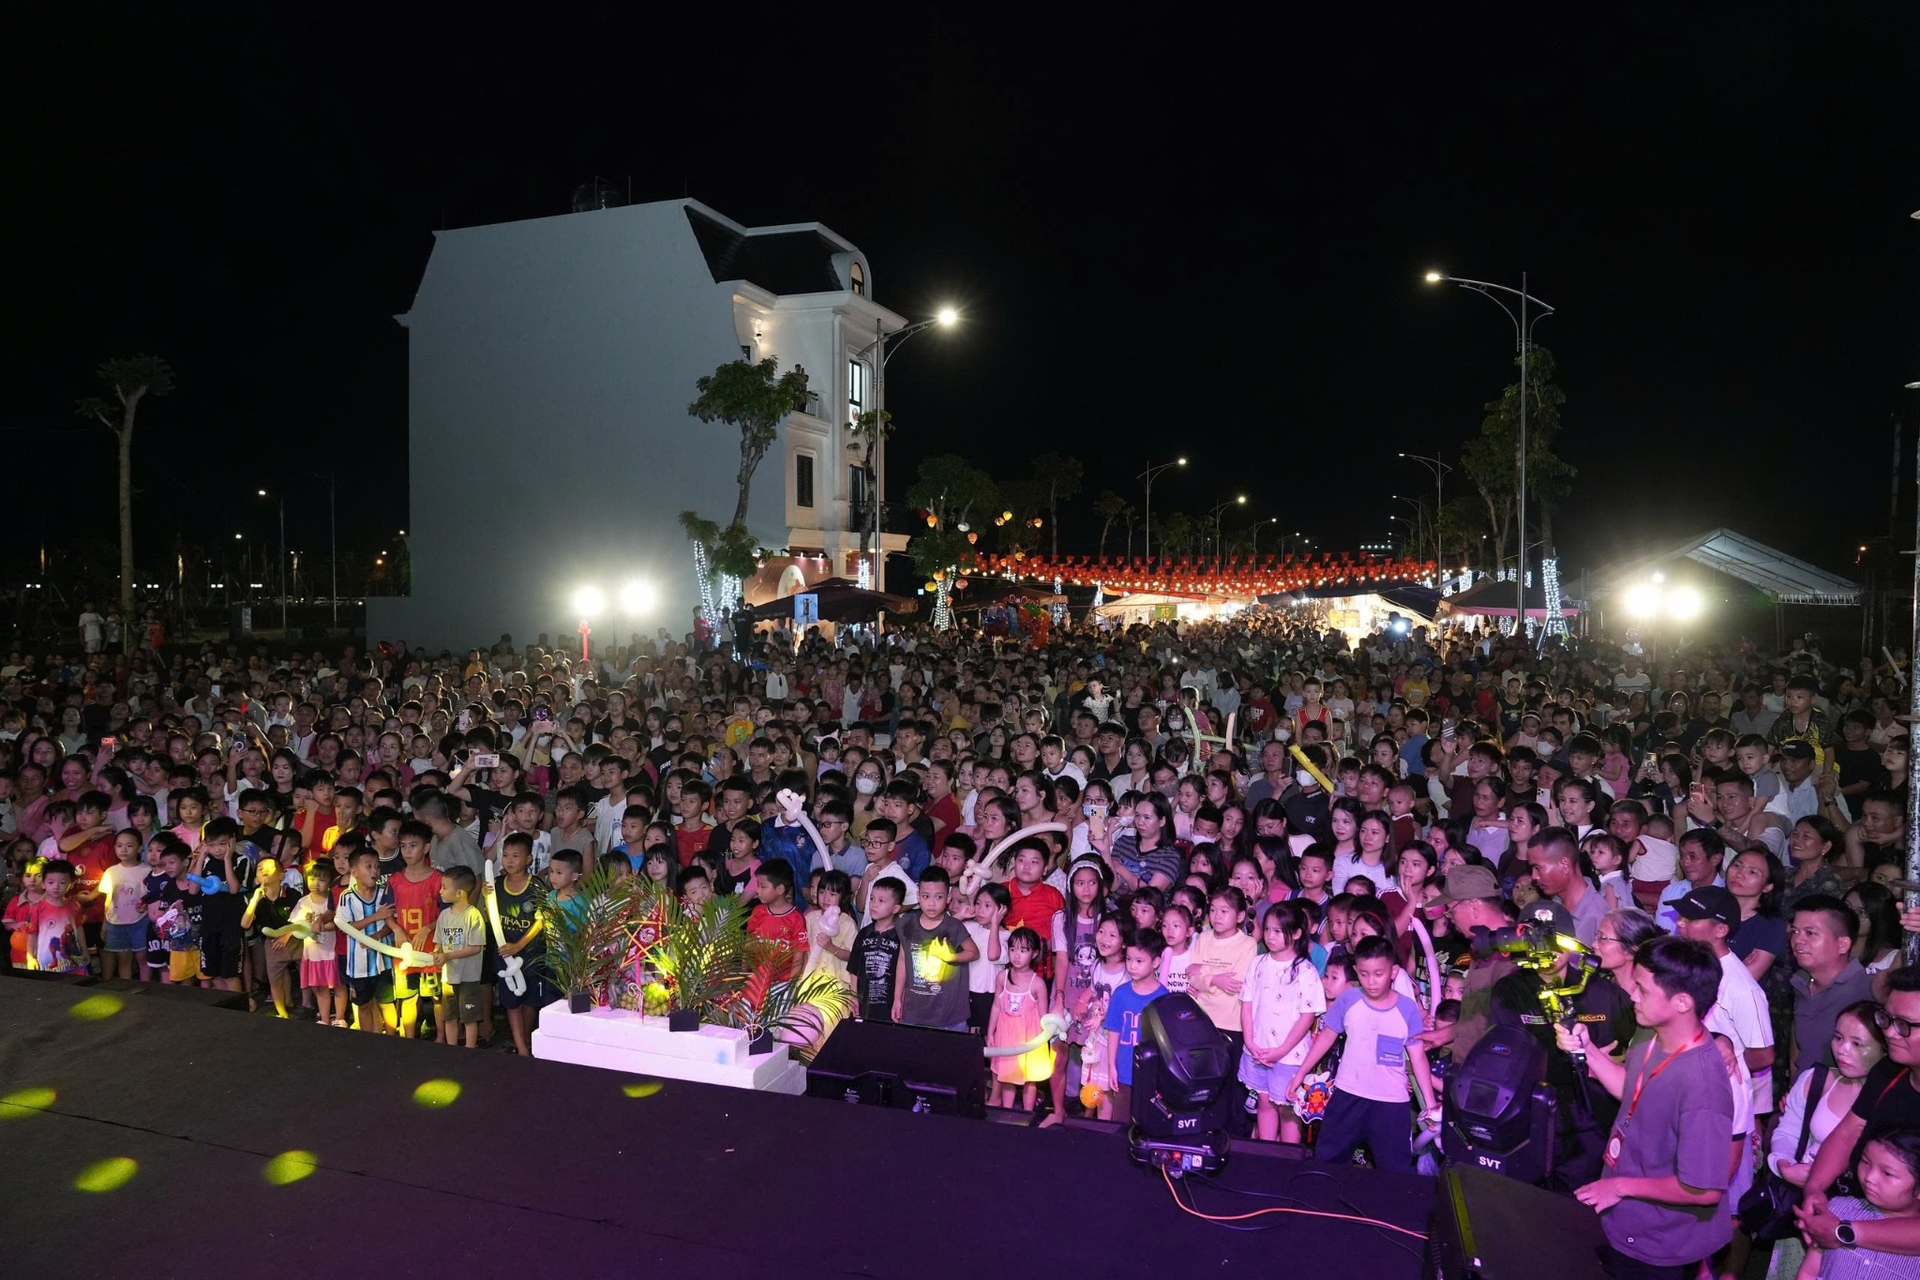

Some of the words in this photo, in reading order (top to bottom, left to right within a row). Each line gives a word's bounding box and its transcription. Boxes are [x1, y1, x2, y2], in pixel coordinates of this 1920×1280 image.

[401, 909, 422, 934] 19
[499, 914, 531, 929] TIHAD
[1178, 1119, 1197, 1129] SVT
[1479, 1156, 1501, 1170] SVT
